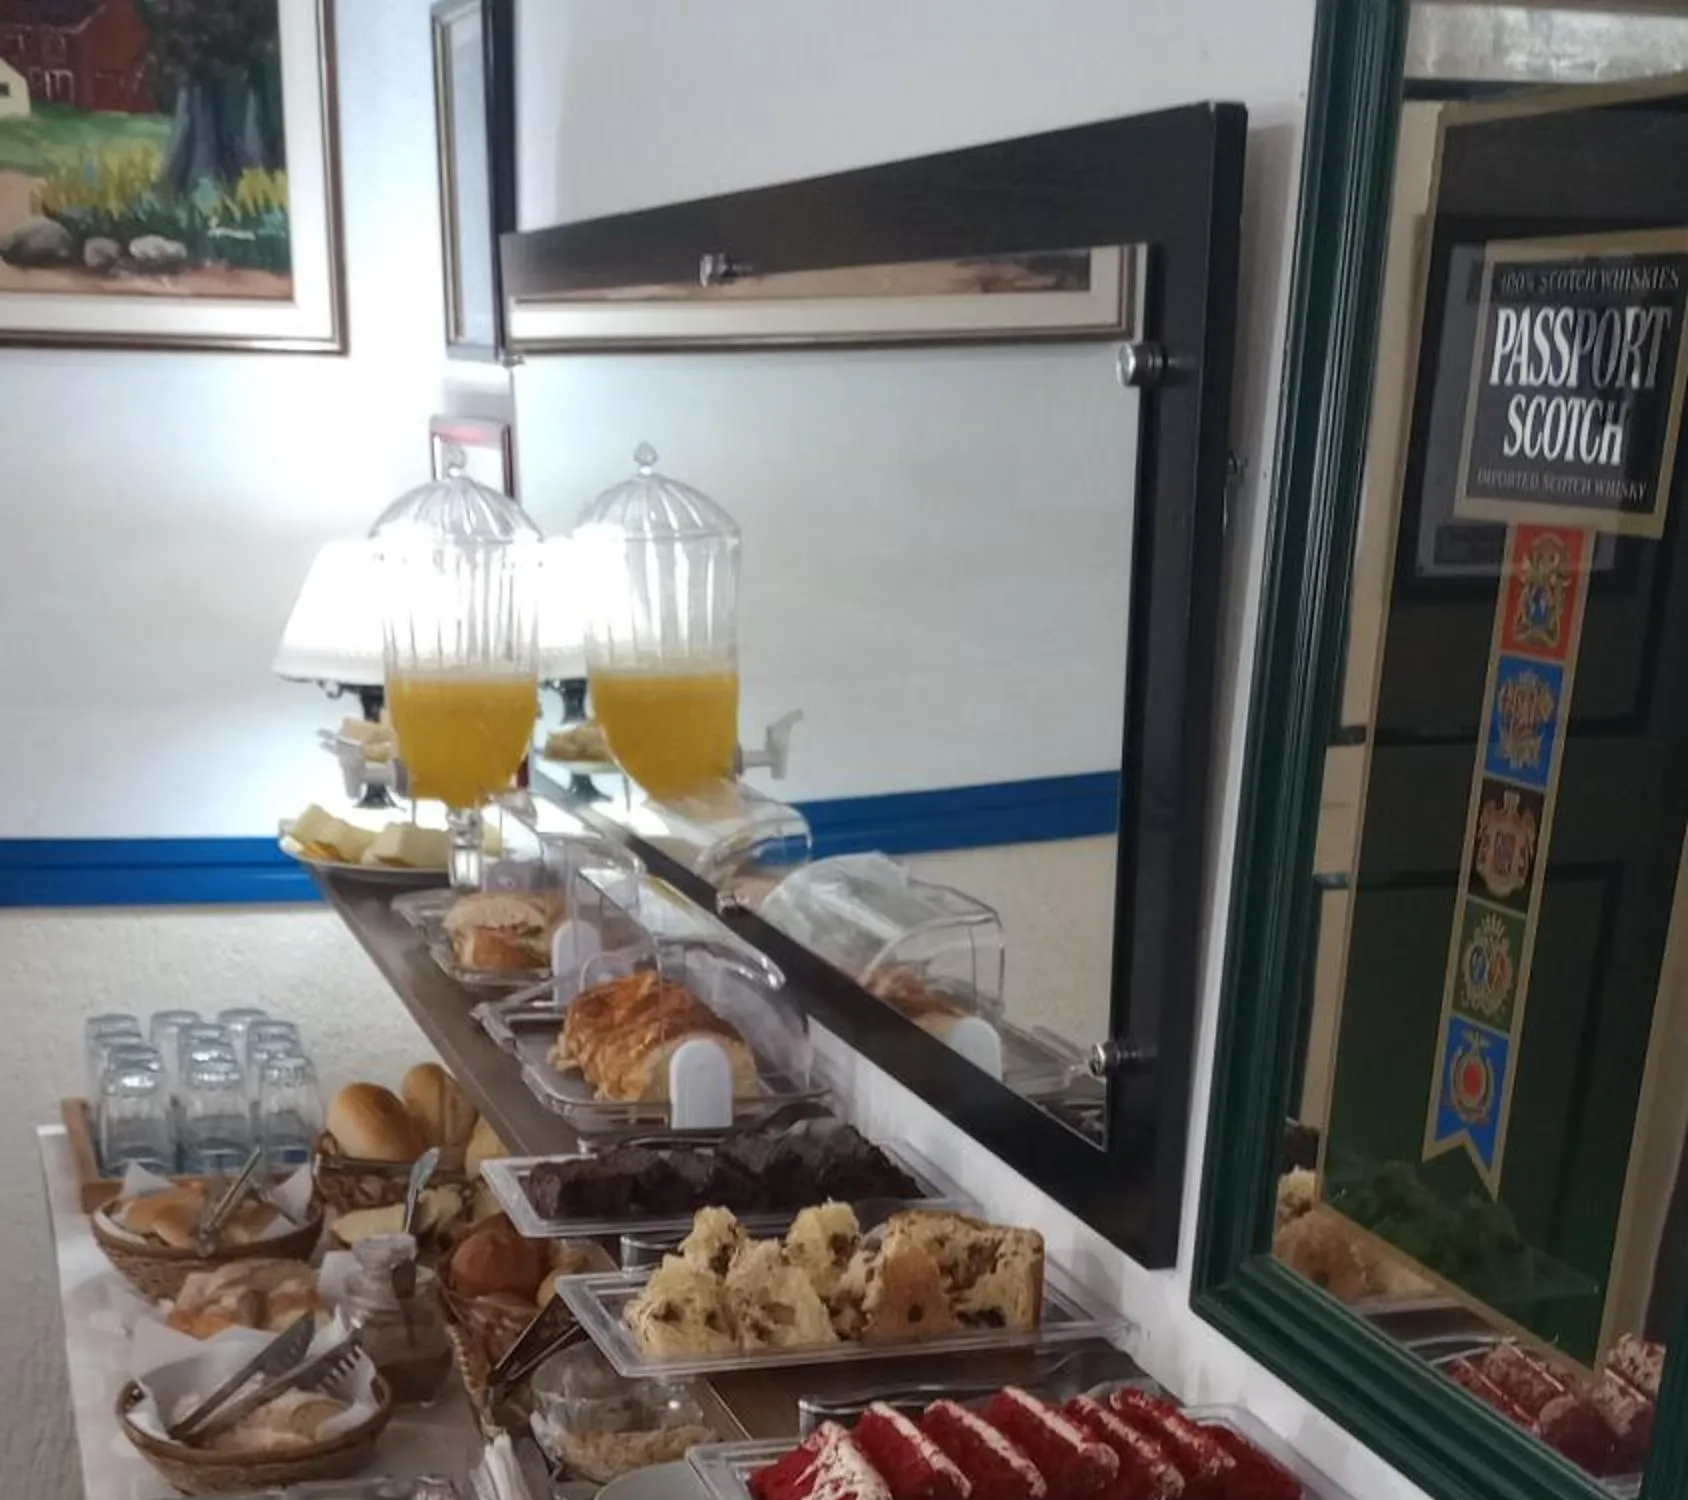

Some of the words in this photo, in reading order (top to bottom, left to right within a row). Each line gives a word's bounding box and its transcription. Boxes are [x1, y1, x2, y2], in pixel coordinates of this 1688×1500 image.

[1540, 267, 1597, 292] SCOTCH
[1599, 262, 1680, 291] WHISKIES
[1489, 306, 1673, 389] PASSPORT
[1503, 393, 1630, 467] SCOTCH
[1542, 472, 1591, 496] SCOTCH
[1595, 478, 1648, 501] WHISKY
